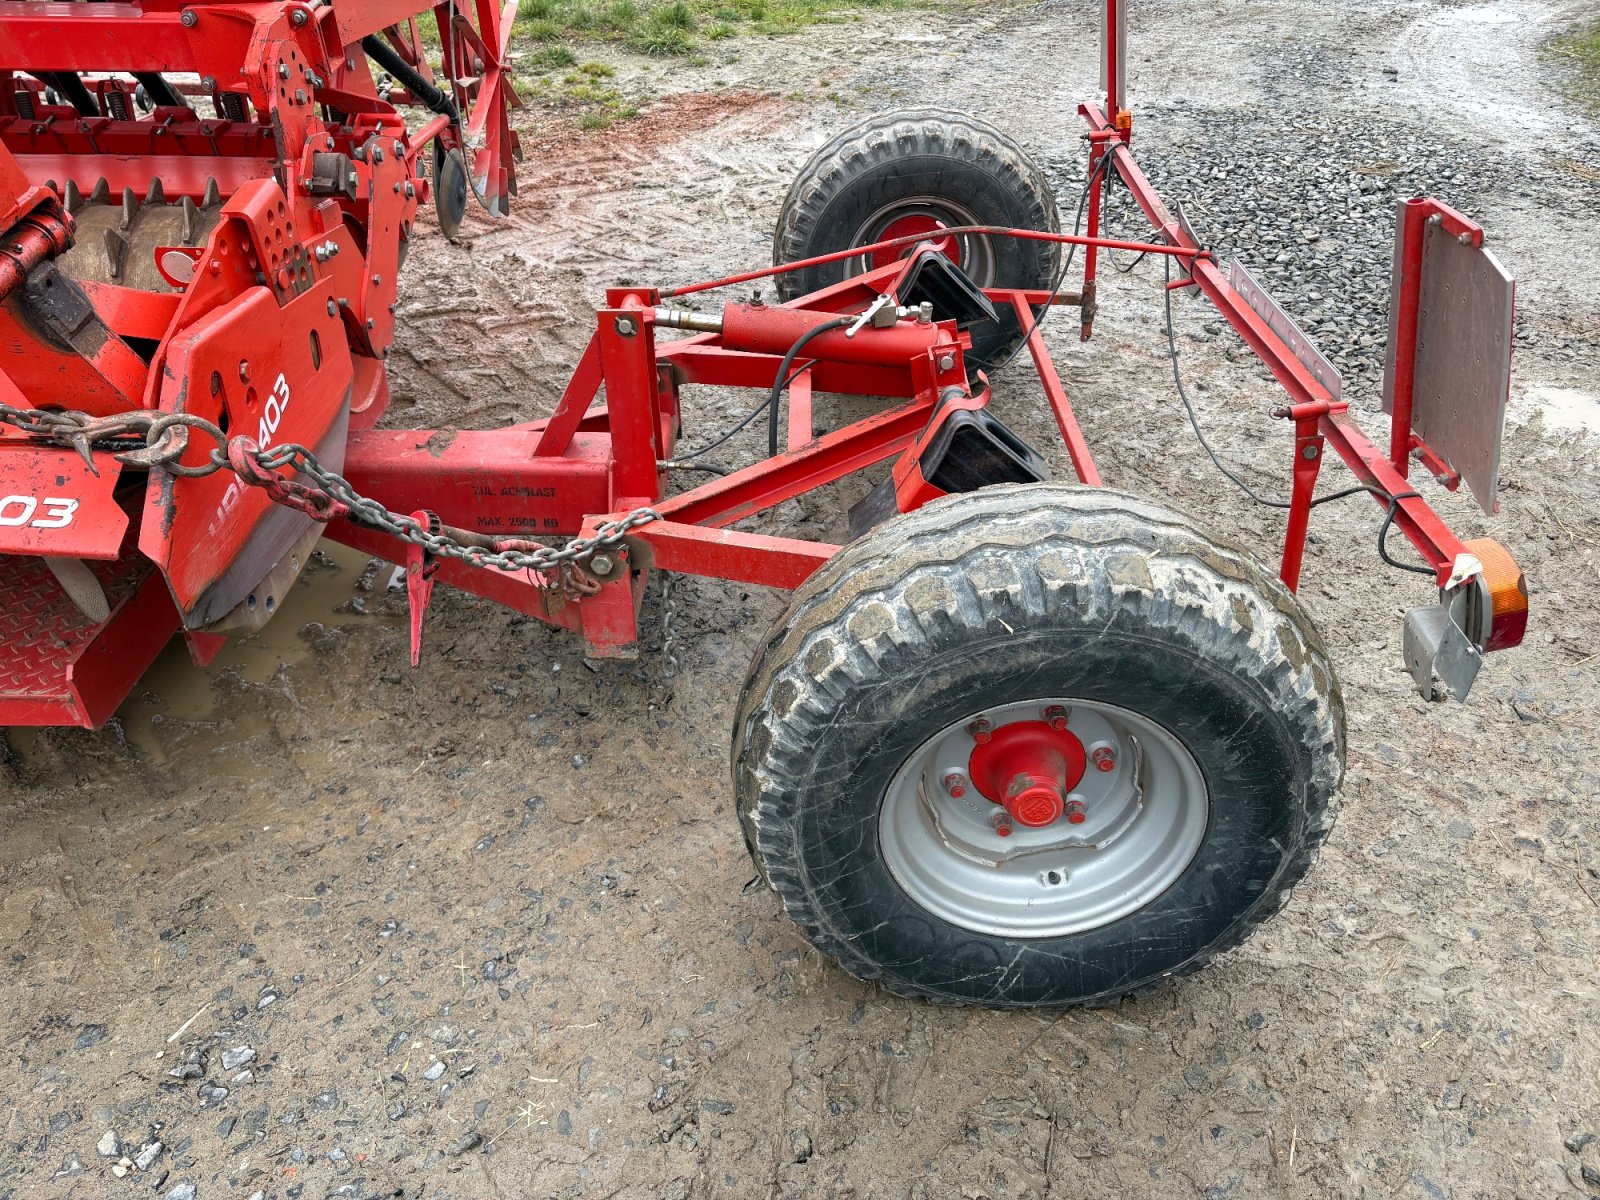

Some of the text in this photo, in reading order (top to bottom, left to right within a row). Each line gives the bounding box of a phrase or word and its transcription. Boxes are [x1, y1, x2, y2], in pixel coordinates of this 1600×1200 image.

[257, 371, 291, 451] 403
[476, 516, 559, 528] MAX. 2500 KG
